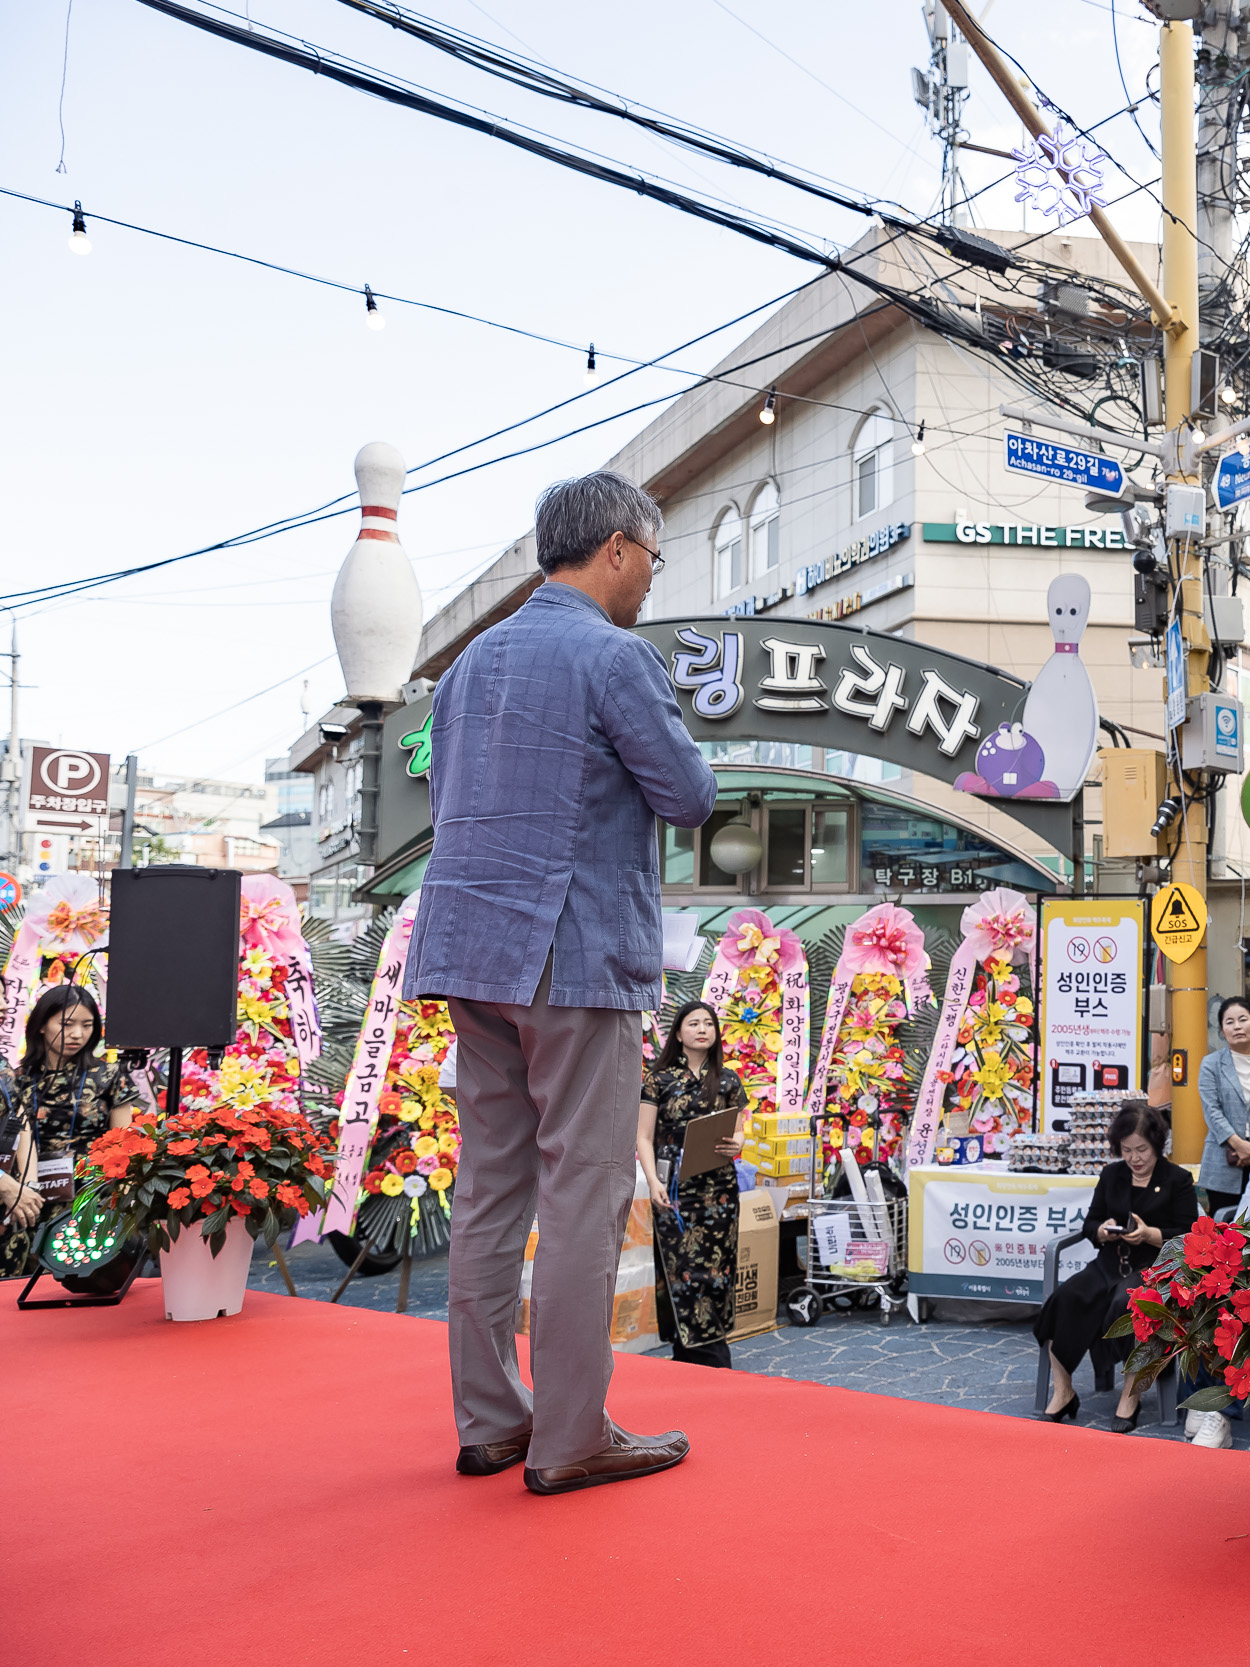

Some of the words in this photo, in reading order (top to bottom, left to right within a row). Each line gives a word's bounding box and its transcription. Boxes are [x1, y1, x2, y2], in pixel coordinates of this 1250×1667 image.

[1008, 437, 1100, 477] 아차산로29길
[1009, 455, 1061, 477] Achasan-ro
[1062, 468, 1088, 484] 29-gil
[955, 521, 992, 543] GS
[997, 523, 1058, 546] THE
[30, 795, 107, 813] 주차장입구
[875, 868, 939, 886] 탁구장
[950, 868, 974, 886] B1
[1168, 919, 1188, 928] SOS
[1164, 935, 1193, 945] 긴급신고
[1057, 972, 1127, 994] 성인인증
[946, 967, 967, 1027] 신한은행
[1074, 997, 1108, 1018] 부스
[346, 960, 403, 1125] 새마을금고
[784, 997, 805, 1106] 화양제일시장
[949, 1203, 1038, 1233] 성인인증
